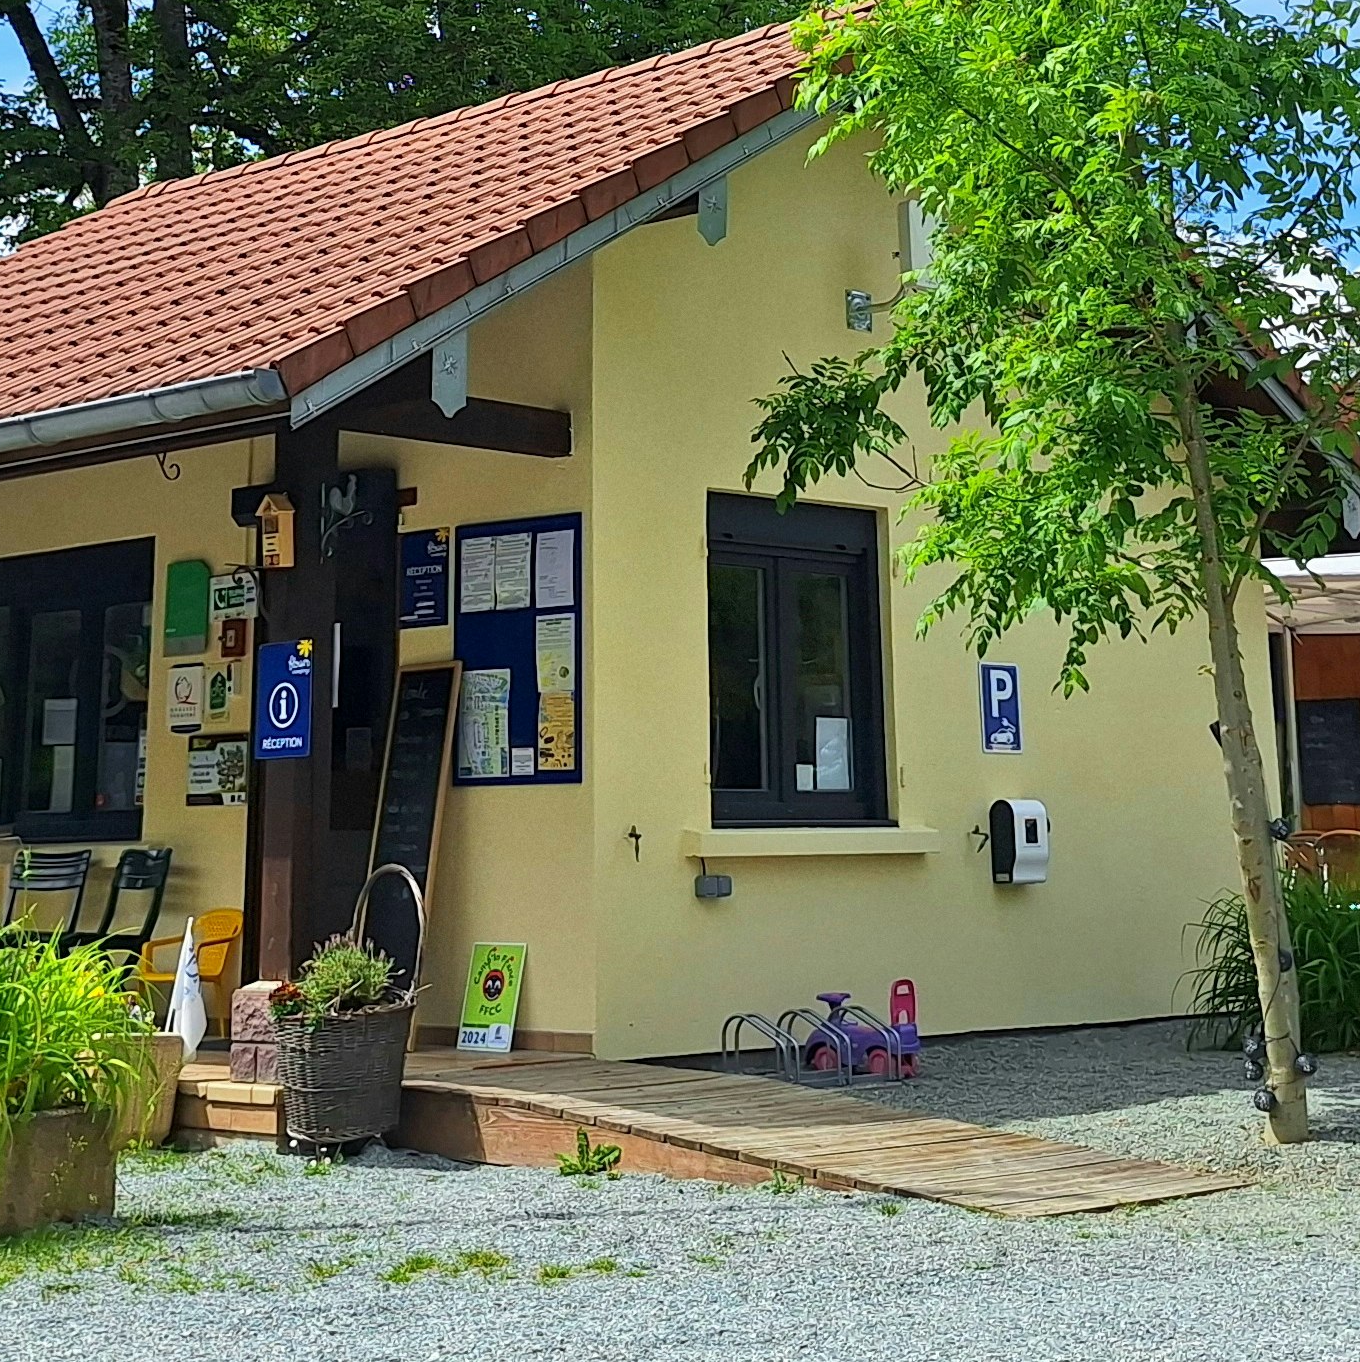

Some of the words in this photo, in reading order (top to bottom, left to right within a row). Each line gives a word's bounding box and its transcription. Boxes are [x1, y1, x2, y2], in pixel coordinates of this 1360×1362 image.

[990, 668, 1013, 718] P
[261, 735, 304, 750] RÉCEPTION
[478, 1002, 503, 1016] FFCC
[461, 1030, 487, 1045] 2024
